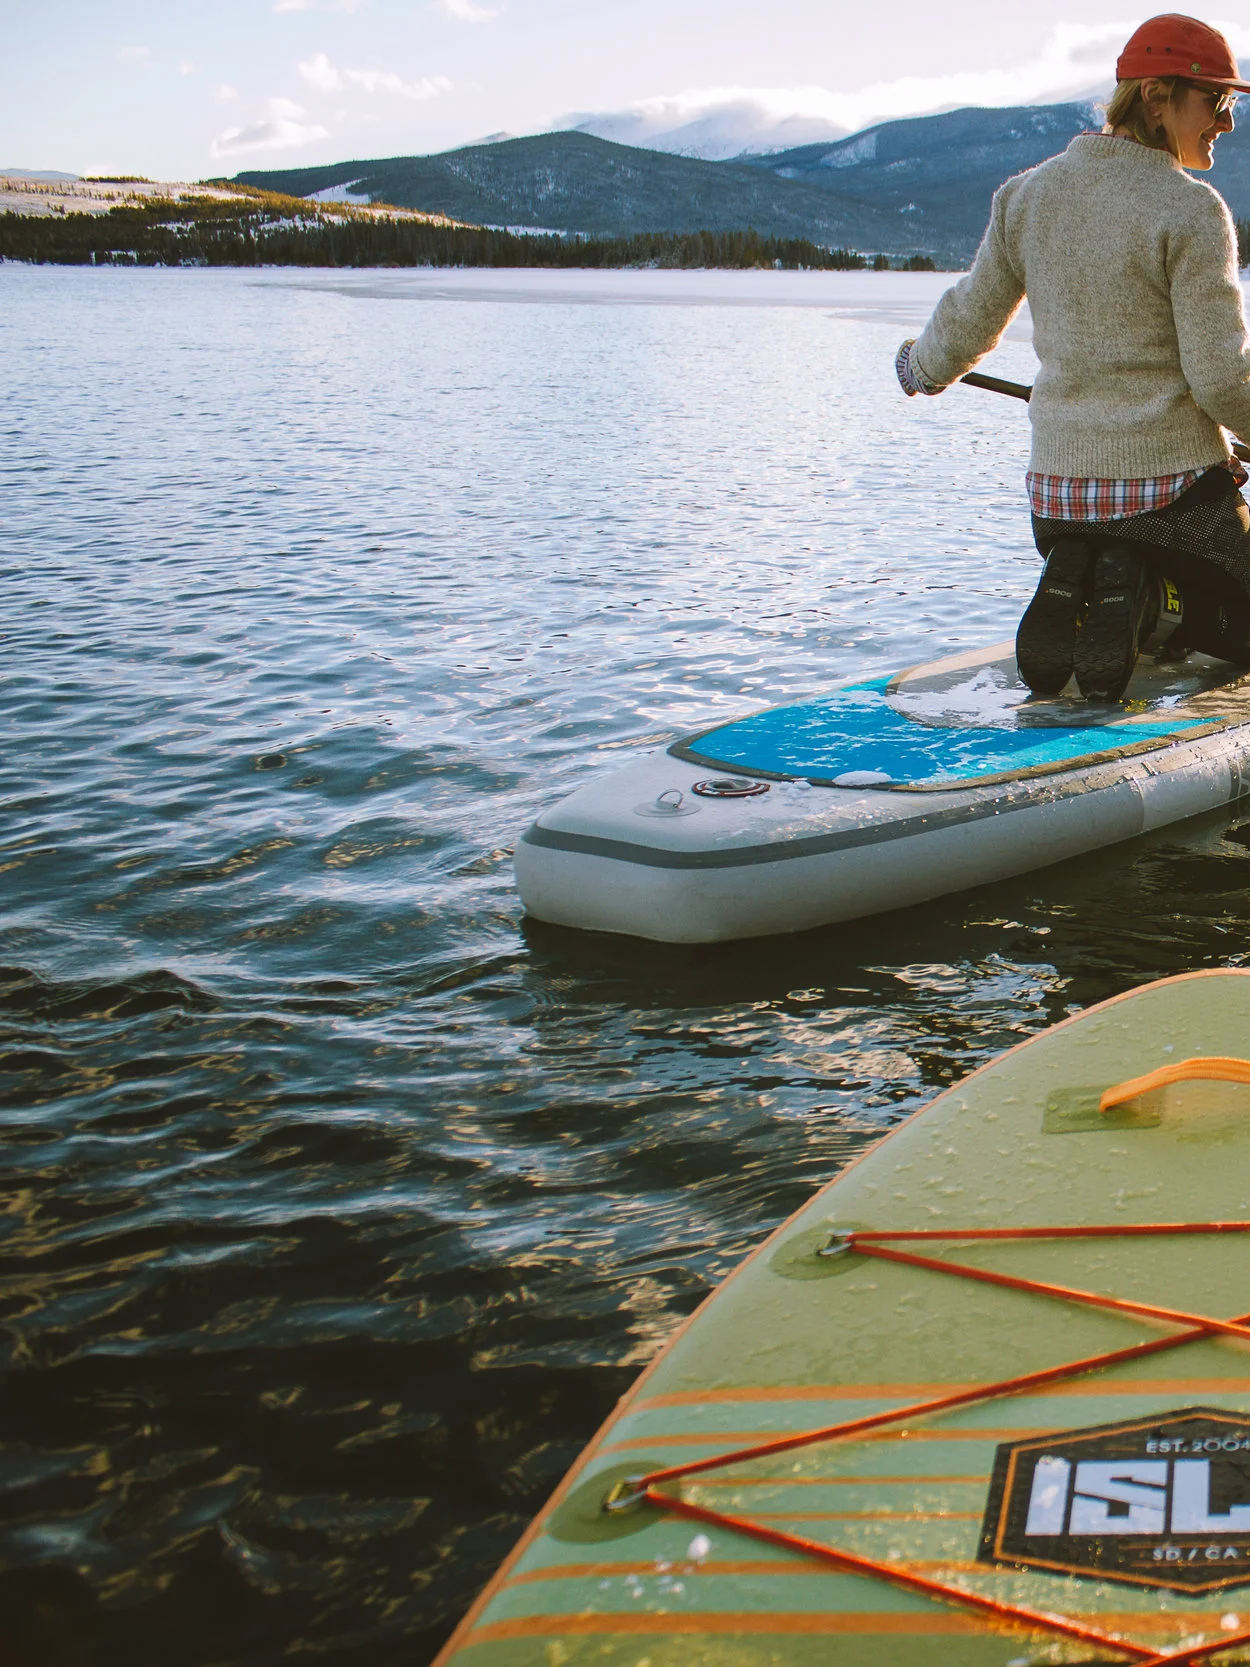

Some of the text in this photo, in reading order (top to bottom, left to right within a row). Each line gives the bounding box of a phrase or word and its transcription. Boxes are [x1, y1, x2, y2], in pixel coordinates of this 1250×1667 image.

[1145, 1438, 1187, 1454] EST.
[1152, 1546, 1181, 1561] SD
[1204, 1546, 1239, 1561] CA
